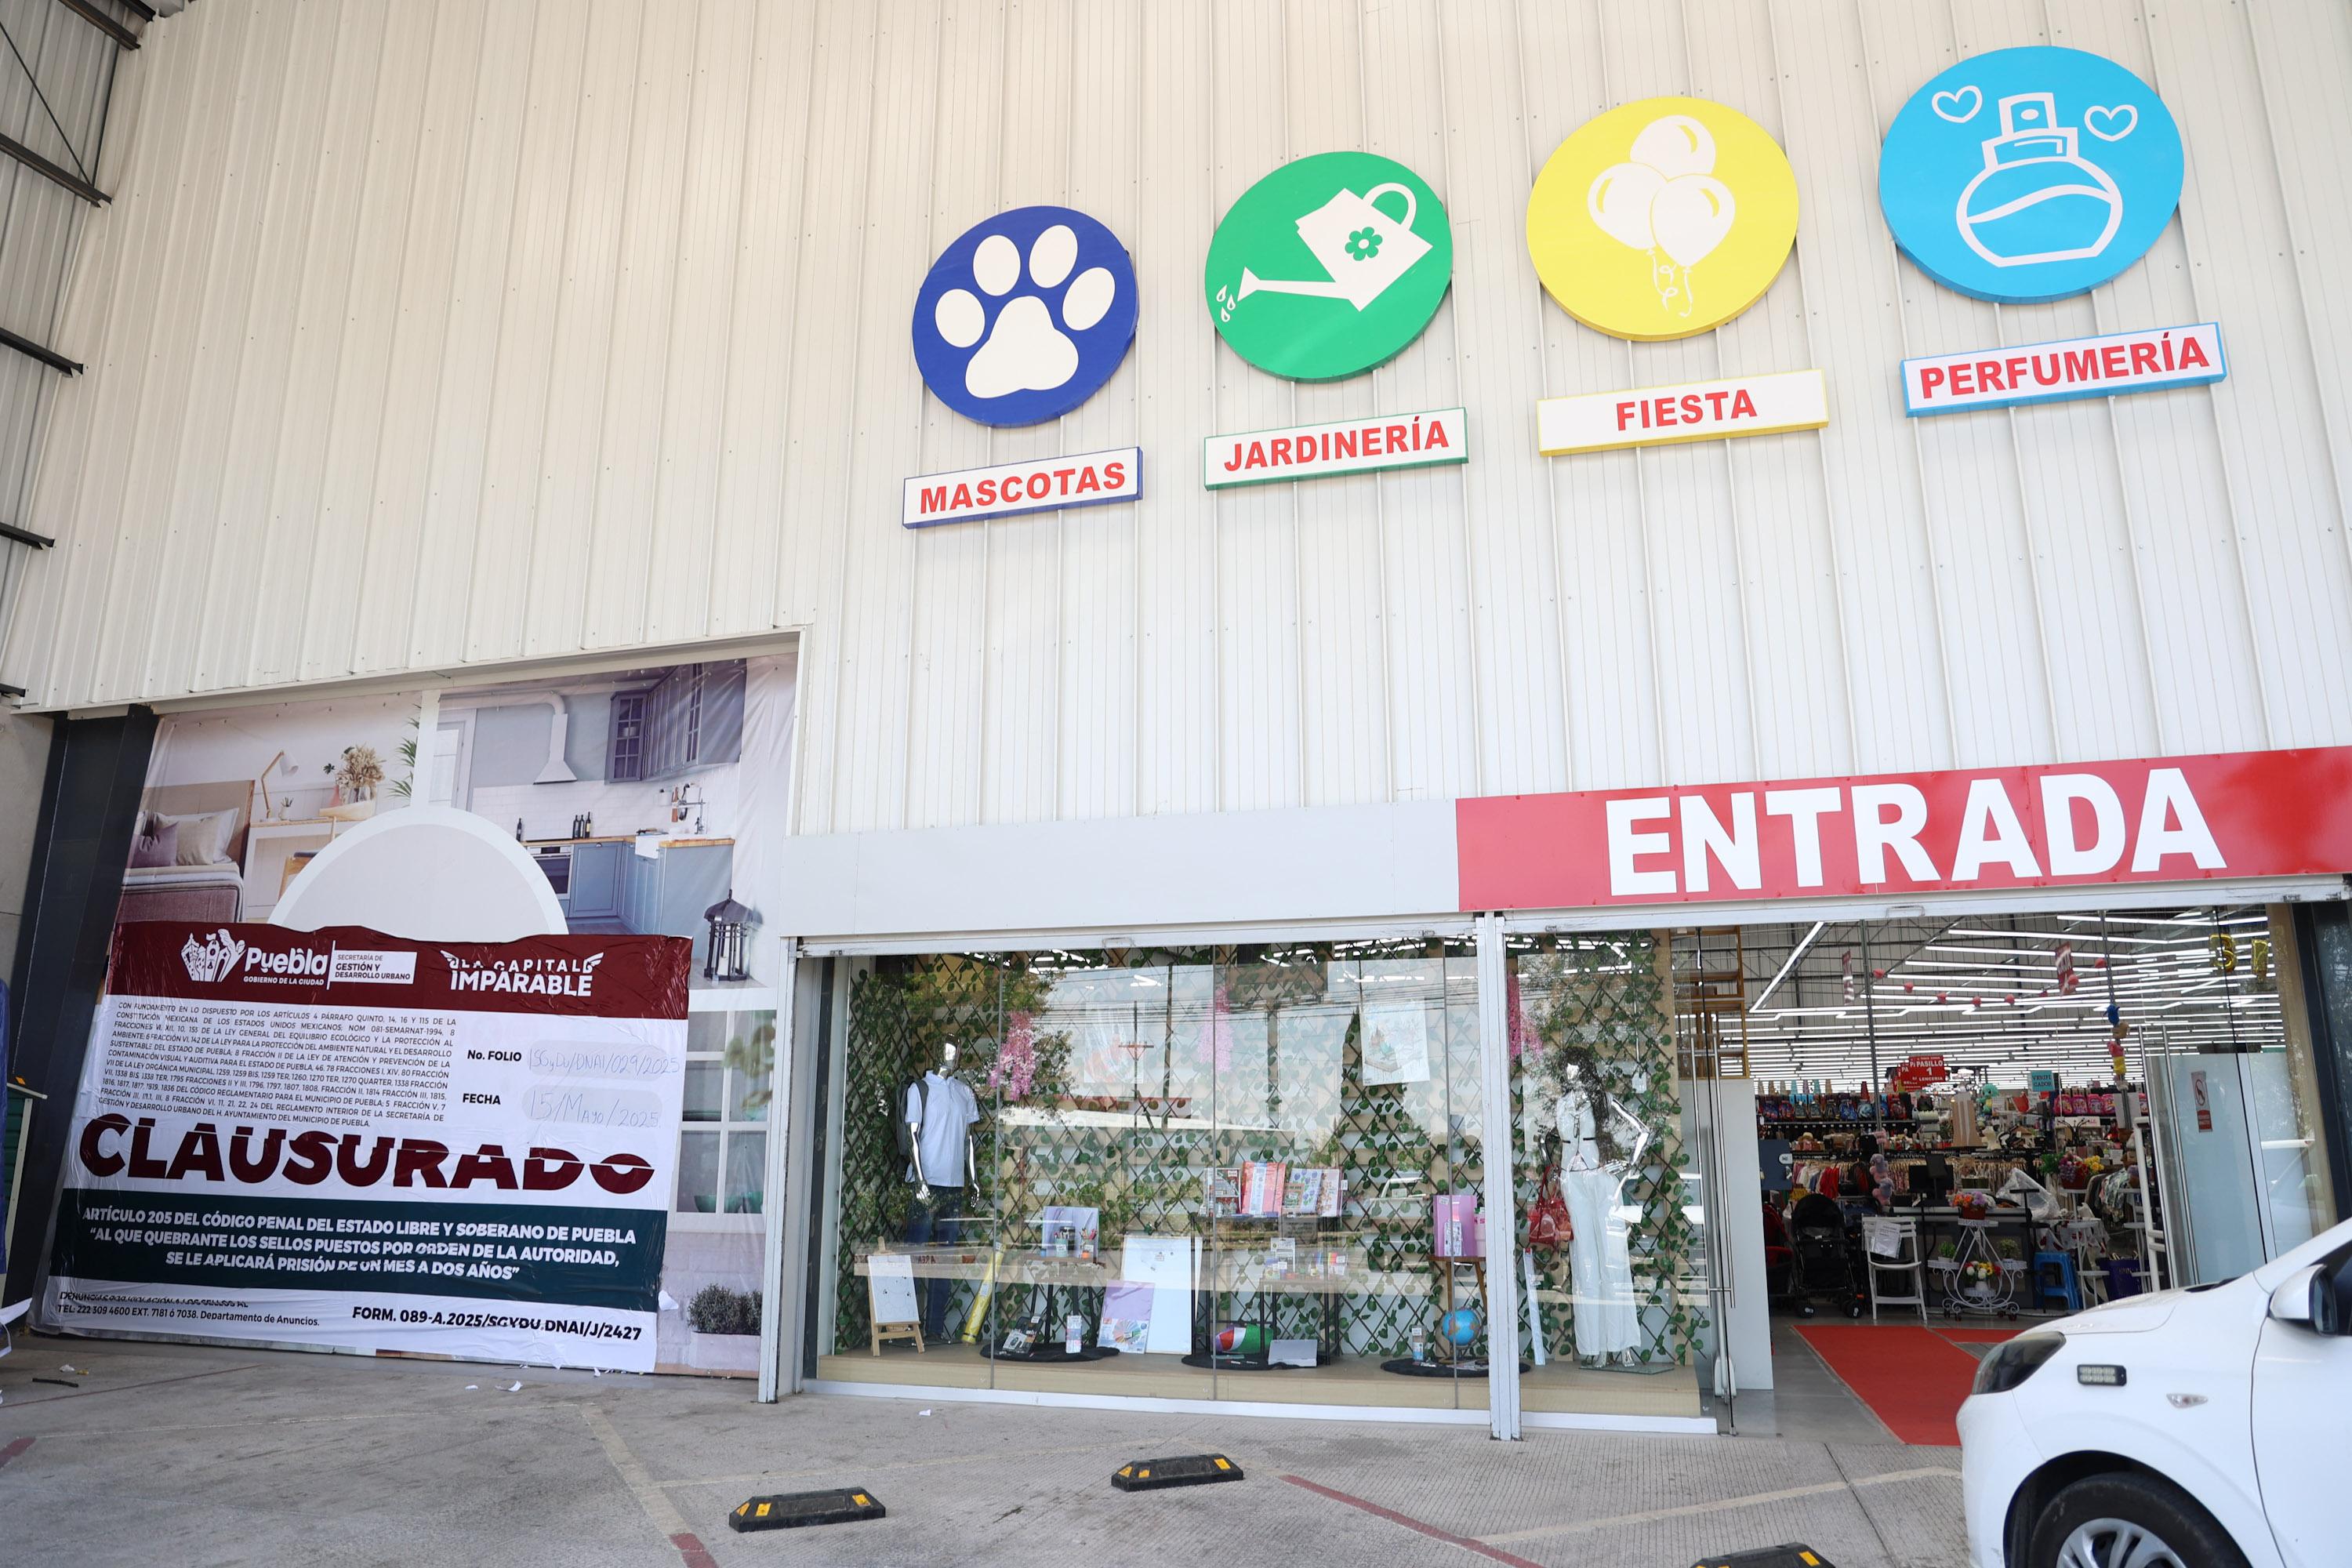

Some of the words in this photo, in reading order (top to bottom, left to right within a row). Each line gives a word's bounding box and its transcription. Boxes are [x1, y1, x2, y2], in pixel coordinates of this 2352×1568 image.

[1921, 332, 2209, 399] PERFUMERÍA
[1617, 390, 1757, 431] FIESTA
[1225, 415, 1449, 471] JARDINERÍA
[920, 463, 1125, 514] MASCOTAS
[1606, 768, 2227, 896] ENTRADA
[245, 947, 328, 975] Puebla
[336, 962, 372, 971] GESTIÓN
[461, 959, 483, 968] LA
[493, 959, 580, 972] CAPITAL
[451, 970, 593, 997] IMPARABLE
[234, 1018, 264, 1027] ESTADOS
[167, 1044, 193, 1053] ESTADO
[241, 1049, 275, 1058] FRACCIÓN
[333, 1054, 369, 1063] ATENCIÓN
[378, 1057, 425, 1066] PREVENCIÓN
[260, 1040, 303, 1050] PROTECCIÓN
[318, 1044, 354, 1052] AMBIENTE
[354, 1045, 387, 1054] NATURAL
[403, 1047, 452, 1057] DESARROLLO
[466, 1049, 485, 1059] No.
[487, 1050, 521, 1062] FOLIO
[188, 1056, 218, 1065] AUDITIVA
[220, 1058, 238, 1066] PARA
[248, 1060, 274, 1069] ESTADO
[335, 1065, 379, 1074] FRACCIONES
[411, 1069, 448, 1078] FRACCIÓN
[462, 1093, 500, 1105] FECHA
[129, 1102, 172, 1112] DESARROLLO
[172, 1105, 201, 1114] URBANO
[223, 1109, 277, 1120] AYUNTAMIENTO
[292, 1115, 329, 1124] MUNICIPIO
[79, 1112, 655, 1194] CLAUSURADO
[82, 1206, 145, 1222] ARTÍCULO
[147, 1210, 172, 1224] 205
[173, 1211, 199, 1225] DEL
[201, 1210, 255, 1228] CÓDIGO
[256, 1215, 304, 1230] PENAL
[306, 1218, 333, 1232] DEL
[336, 1218, 394, 1234] ESTADO
[396, 1221, 440, 1236] LIBRE
[442, 1221, 454, 1236] Y
[455, 1222, 544, 1239] SOBERANO
[546, 1225, 568, 1240] DE
[571, 1226, 636, 1244] PUEBLA
[114, 1229, 142, 1243] QUE
[143, 1230, 227, 1247] QUEBRANTE
[229, 1234, 257, 1248] LOS
[258, 1236, 312, 1251] SELLOS
[314, 1238, 380, 1254] PUESTOS
[382, 1241, 413, 1254] POR
[415, 1242, 470, 1256] ORDEN
[471, 1243, 494, 1258] DE
[495, 1244, 517, 1259] LA
[519, 1246, 619, 1267] AUTORIDAD,
[165, 1251, 183, 1264] SE
[185, 1252, 202, 1265] LE
[203, 1253, 274, 1269] APLICARÁ
[277, 1254, 336, 1272] PRISIÓN
[383, 1259, 415, 1272] MES
[416, 1260, 428, 1273] A
[430, 1261, 465, 1276] DOS
[77, 1304, 91, 1313] 222
[92, 1305, 107, 1314] 309
[108, 1306, 130, 1316] 4600
[131, 1307, 149, 1316] EXT.
[151, 1308, 167, 1317] 7181
[169, 1308, 174, 1317] ó
[176, 1308, 198, 1319] 7038.
[200, 1310, 262, 1322] Departamento
[263, 1313, 274, 1323] de
[276, 1315, 319, 1326] Anuncios.
[352, 1306, 396, 1321] FORM.
